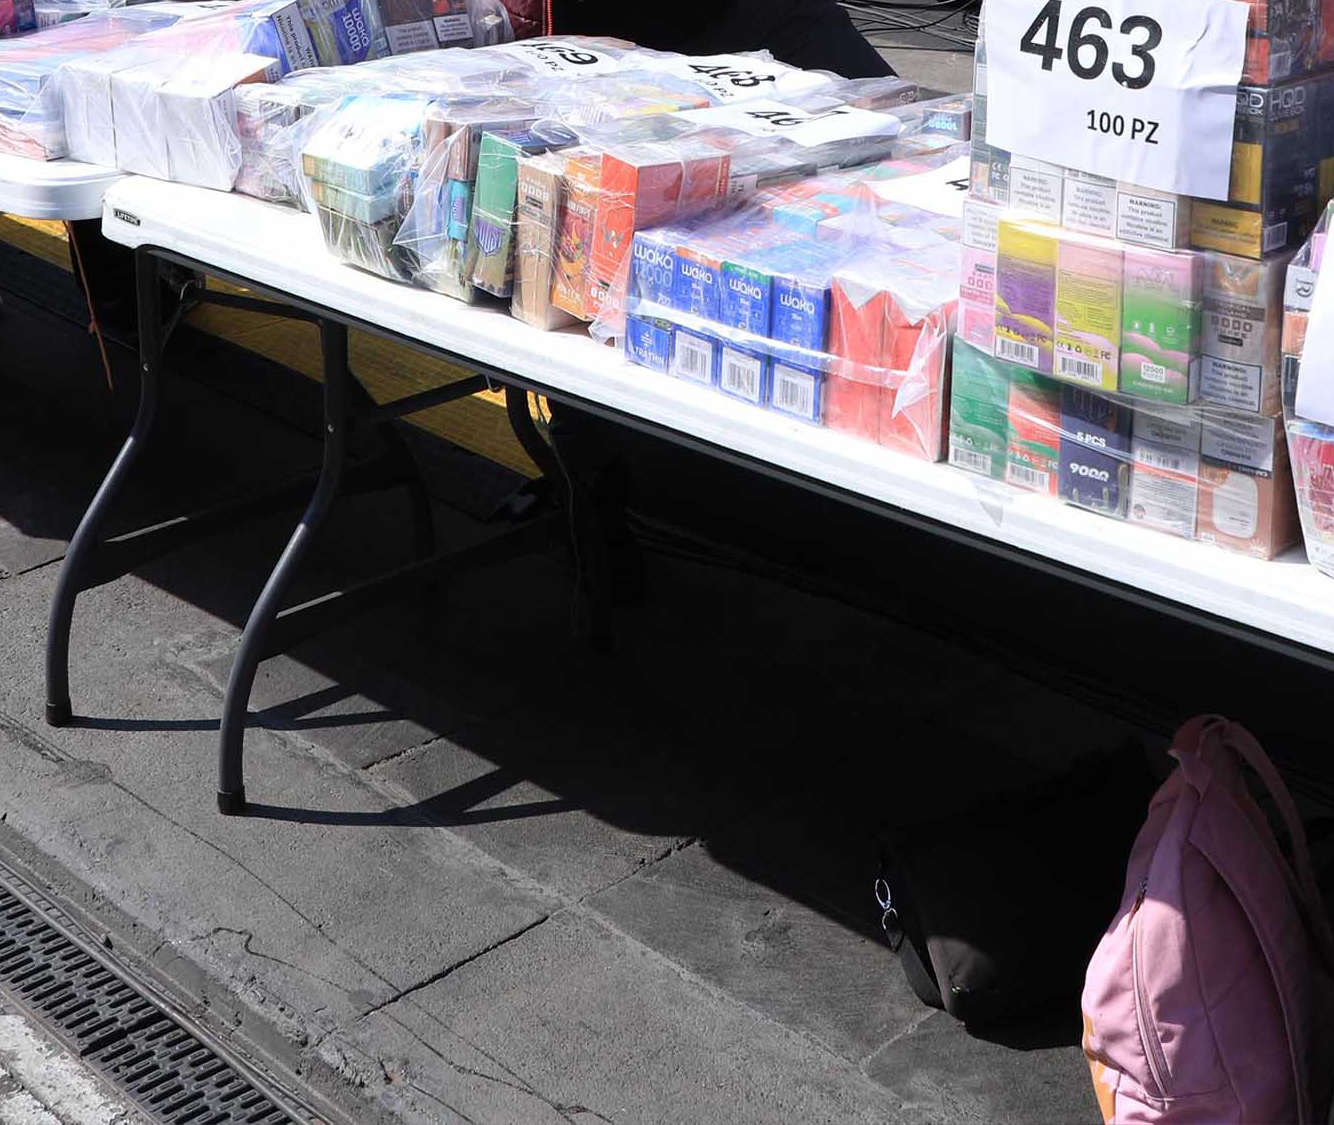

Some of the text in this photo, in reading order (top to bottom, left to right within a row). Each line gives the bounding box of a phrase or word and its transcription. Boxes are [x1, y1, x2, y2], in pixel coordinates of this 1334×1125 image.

[342, 14, 363, 52] 10000
[352, 7, 371, 48] waka
[1269, 87, 1306, 111] HQD
[1087, 109, 1160, 145] 100 PZ
[634, 243, 674, 270] waka
[681, 263, 713, 284] waka
[729, 278, 762, 300] waka
[780, 293, 815, 315] waka
[1085, 434, 1107, 447] PCS
